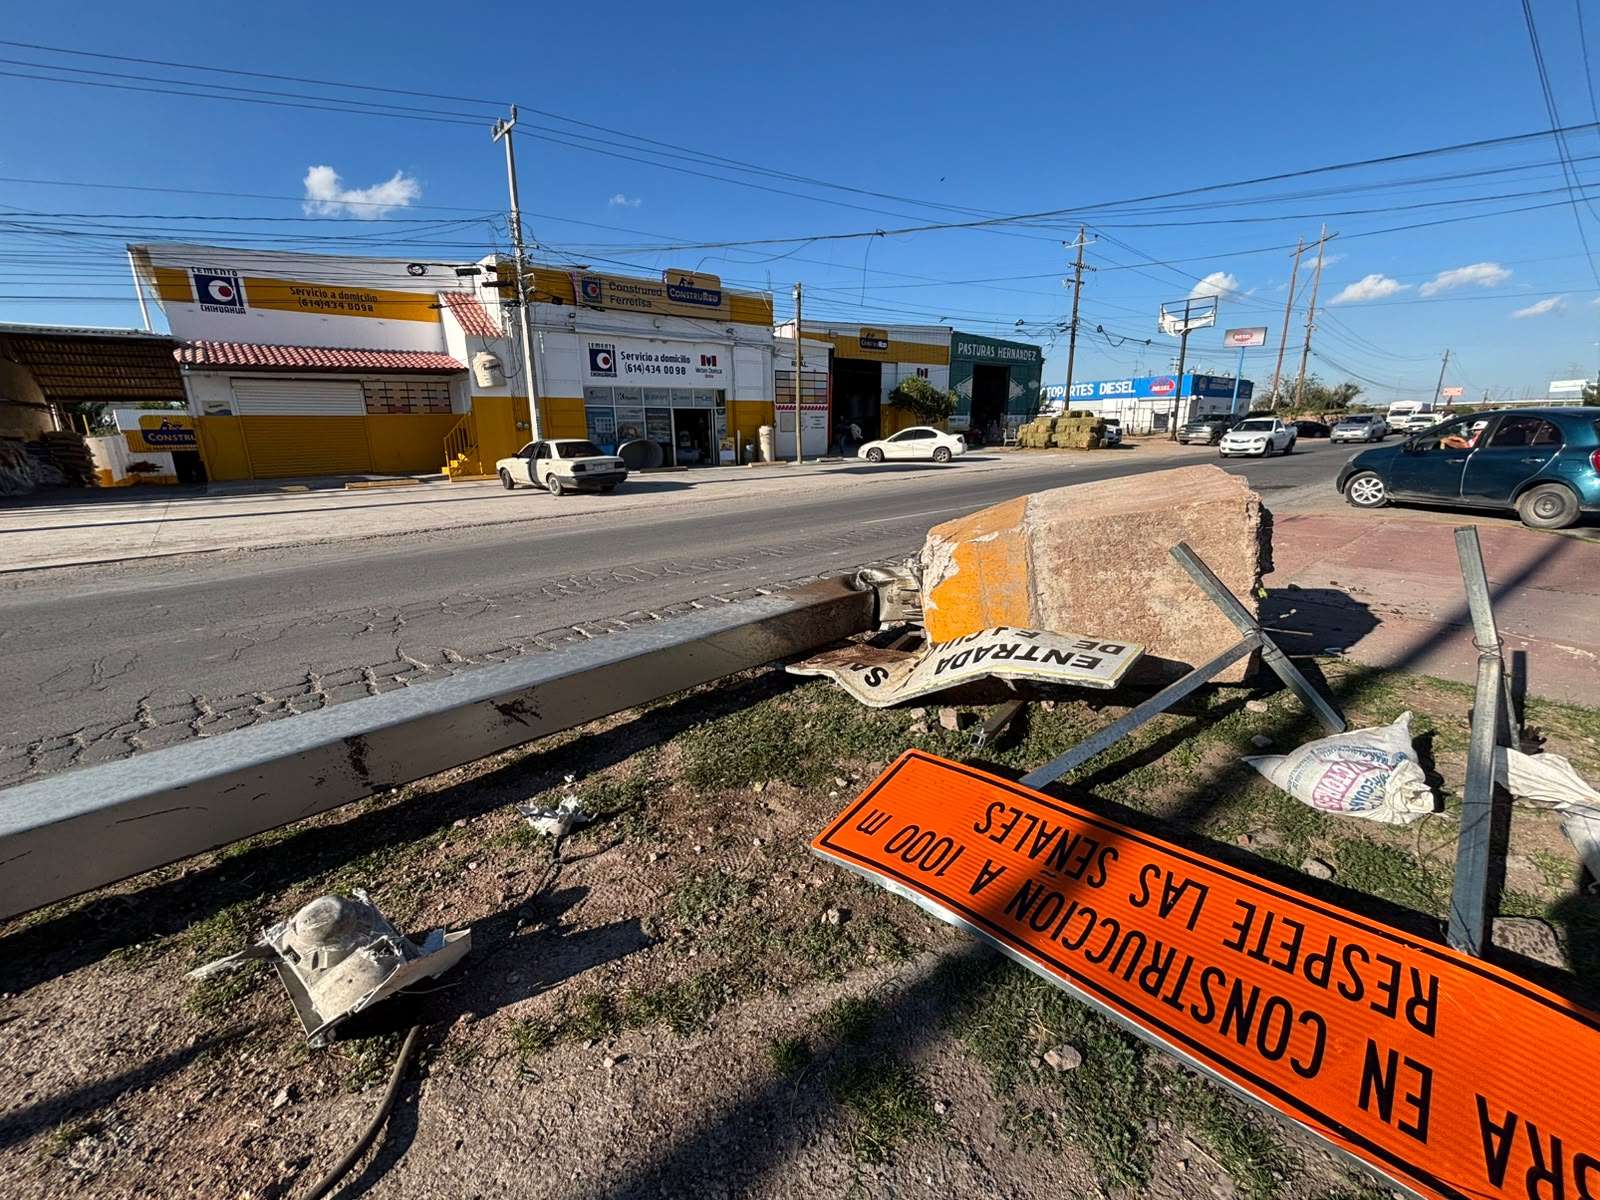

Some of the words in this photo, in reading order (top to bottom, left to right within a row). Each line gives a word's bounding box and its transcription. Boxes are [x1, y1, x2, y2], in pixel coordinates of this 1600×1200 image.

[290, 287, 328, 298] Servicio
[329, 291, 336, 299] a
[338, 290, 378, 303] domicilio
[298, 297, 345, 310] (614)434
[347, 302, 374, 312] 0098
[200, 304, 247, 315] CHIHUAHUA
[620, 351, 653, 362] Servicio
[660, 354, 691, 365] domicilio
[957, 342, 995, 357] PASTURAS
[997, 346, 1036, 361] HERNANDEZ
[624, 361, 661, 375] (614)434
[1099, 381, 1136, 395] DIESEL
[934, 644, 1105, 676] ENTRADA
[1071, 639, 1127, 656] DE
[856, 809, 893, 836] m
[884, 823, 966, 877] 1000
[973, 801, 1120, 889] SEÑALES
[969, 858, 1007, 896] A
[1128, 863, 1210, 932] LAS
[1002, 878, 1328, 1079] CONSTRUCCION
[1221, 899, 1440, 1039] RESPETE
[1358, 1039, 1433, 1145] EN
